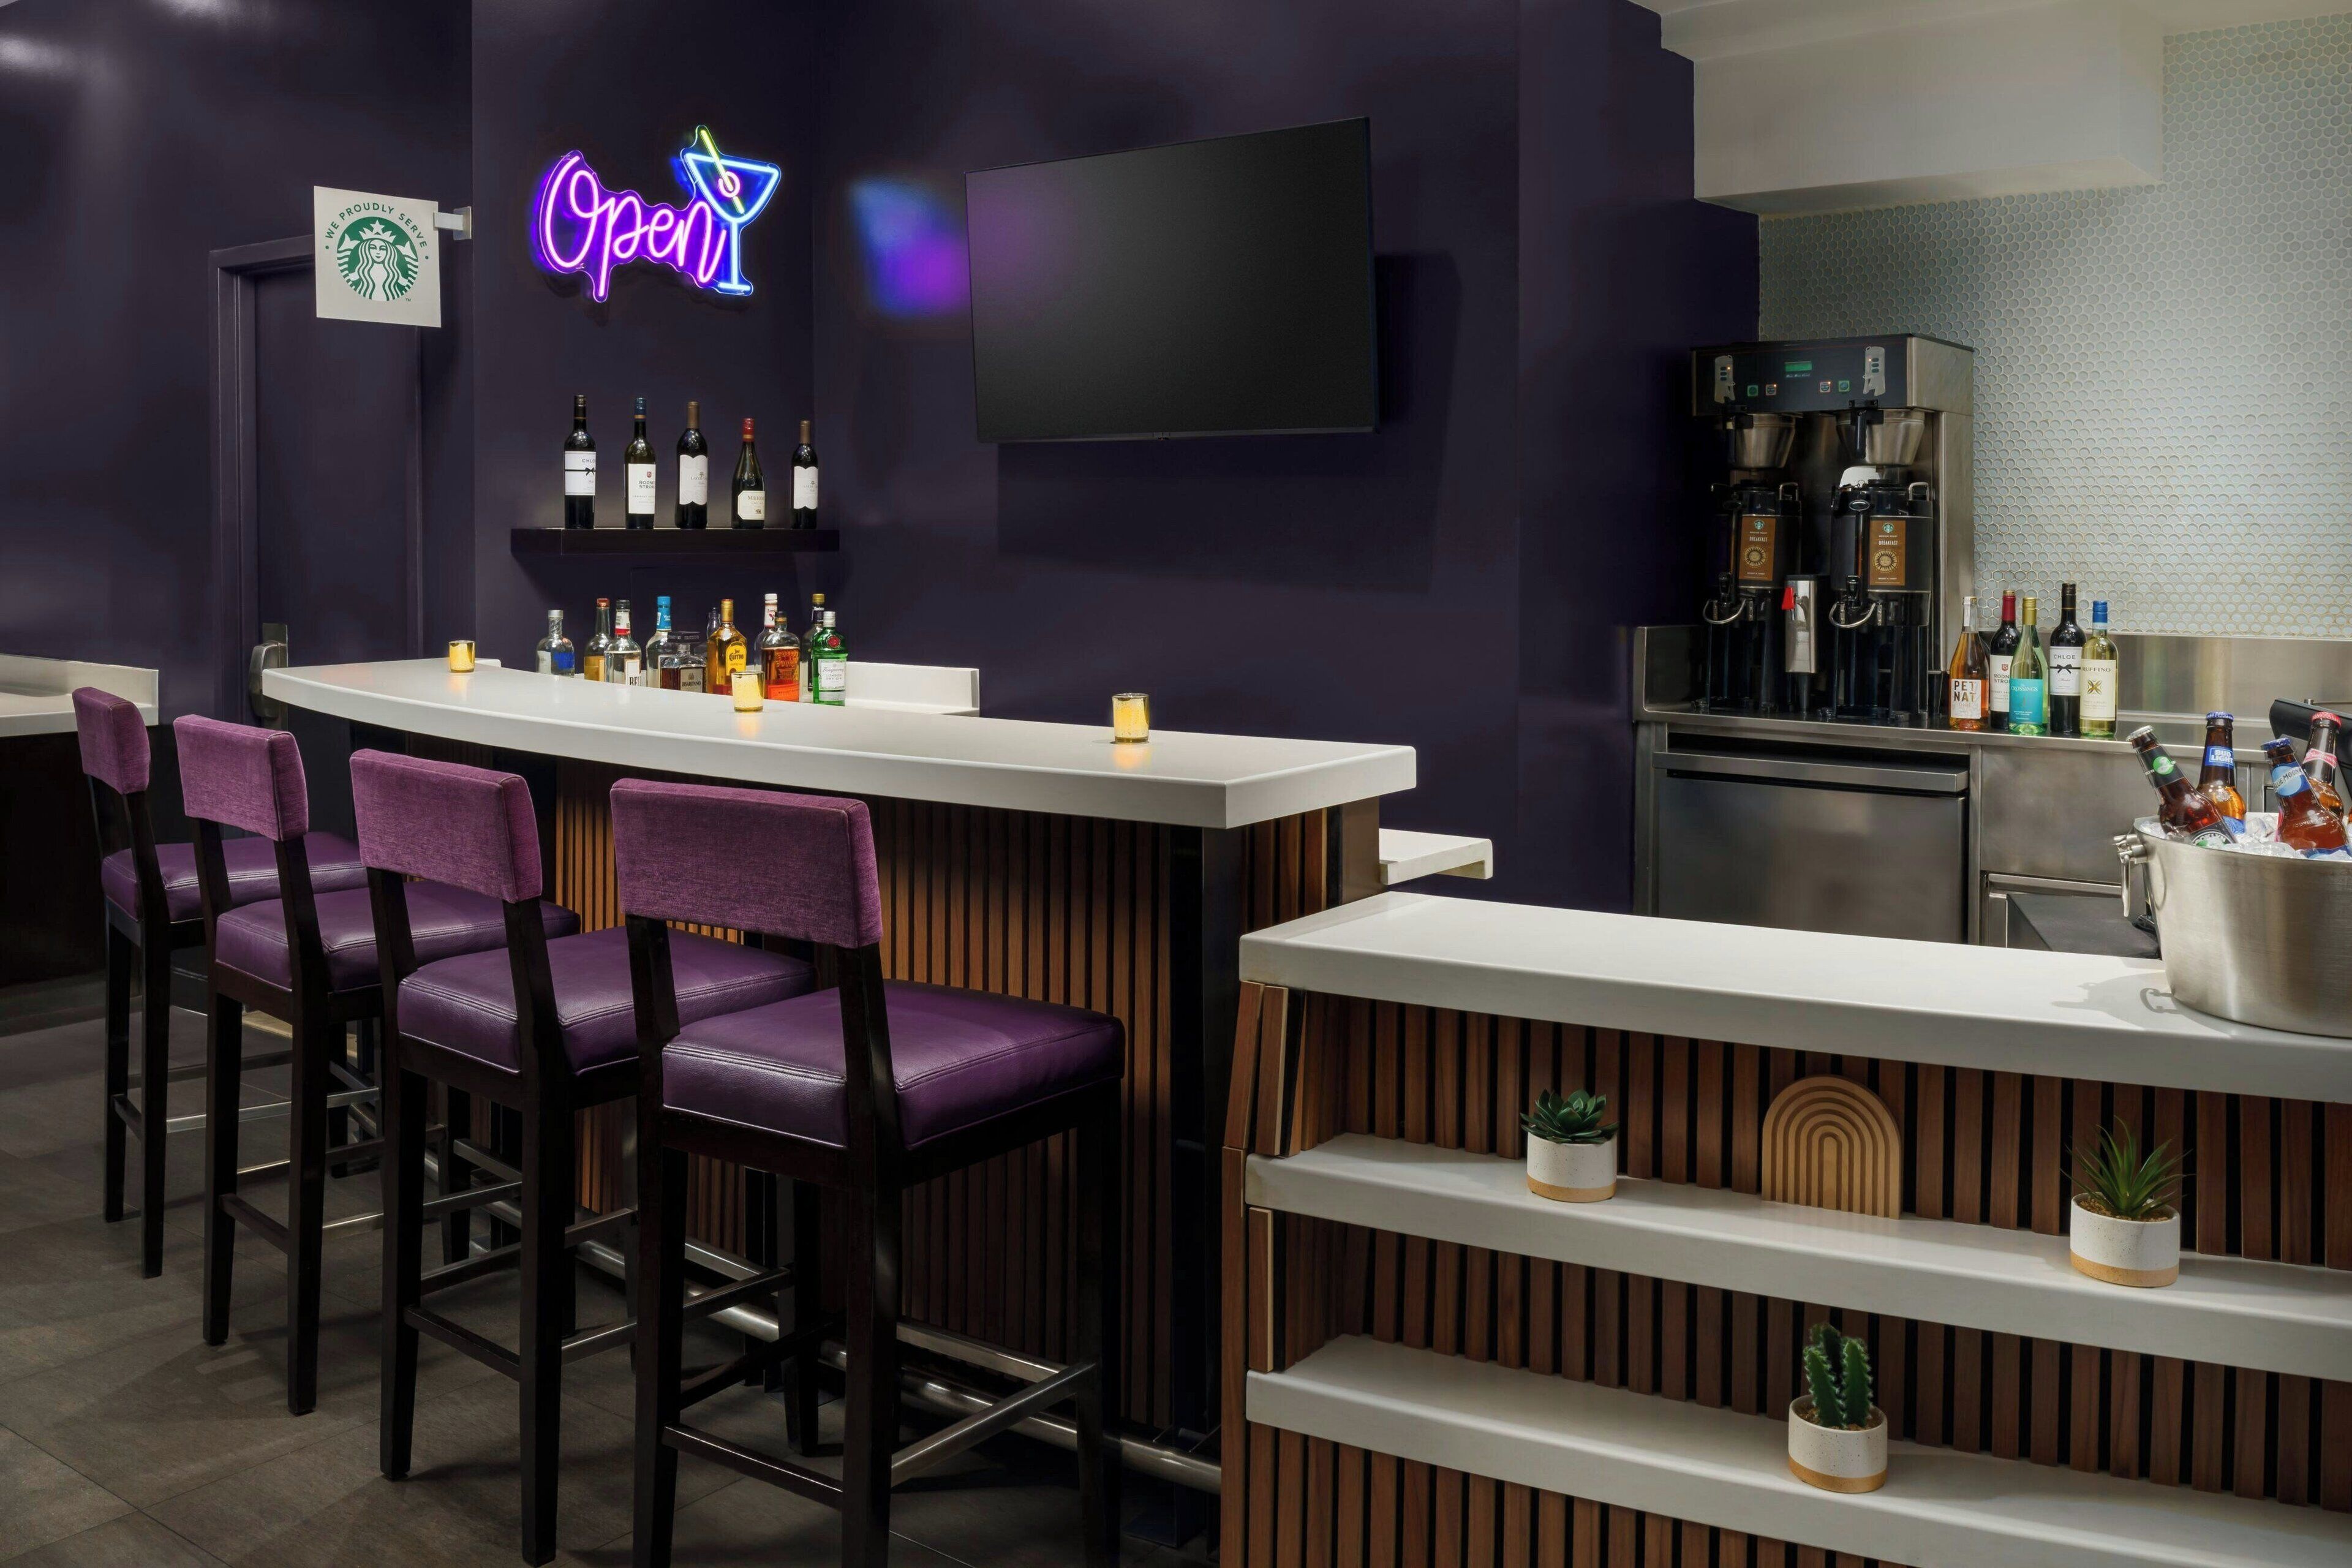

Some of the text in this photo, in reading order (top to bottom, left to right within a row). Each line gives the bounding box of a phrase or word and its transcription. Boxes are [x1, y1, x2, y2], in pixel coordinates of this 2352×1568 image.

[325, 202, 428, 249] WE PROUDLY SERVE
[545, 154, 727, 297] Open
[1954, 680, 1977, 691] PET
[1954, 692, 1977, 702] NAT
[2214, 749, 2231, 758] BUD
